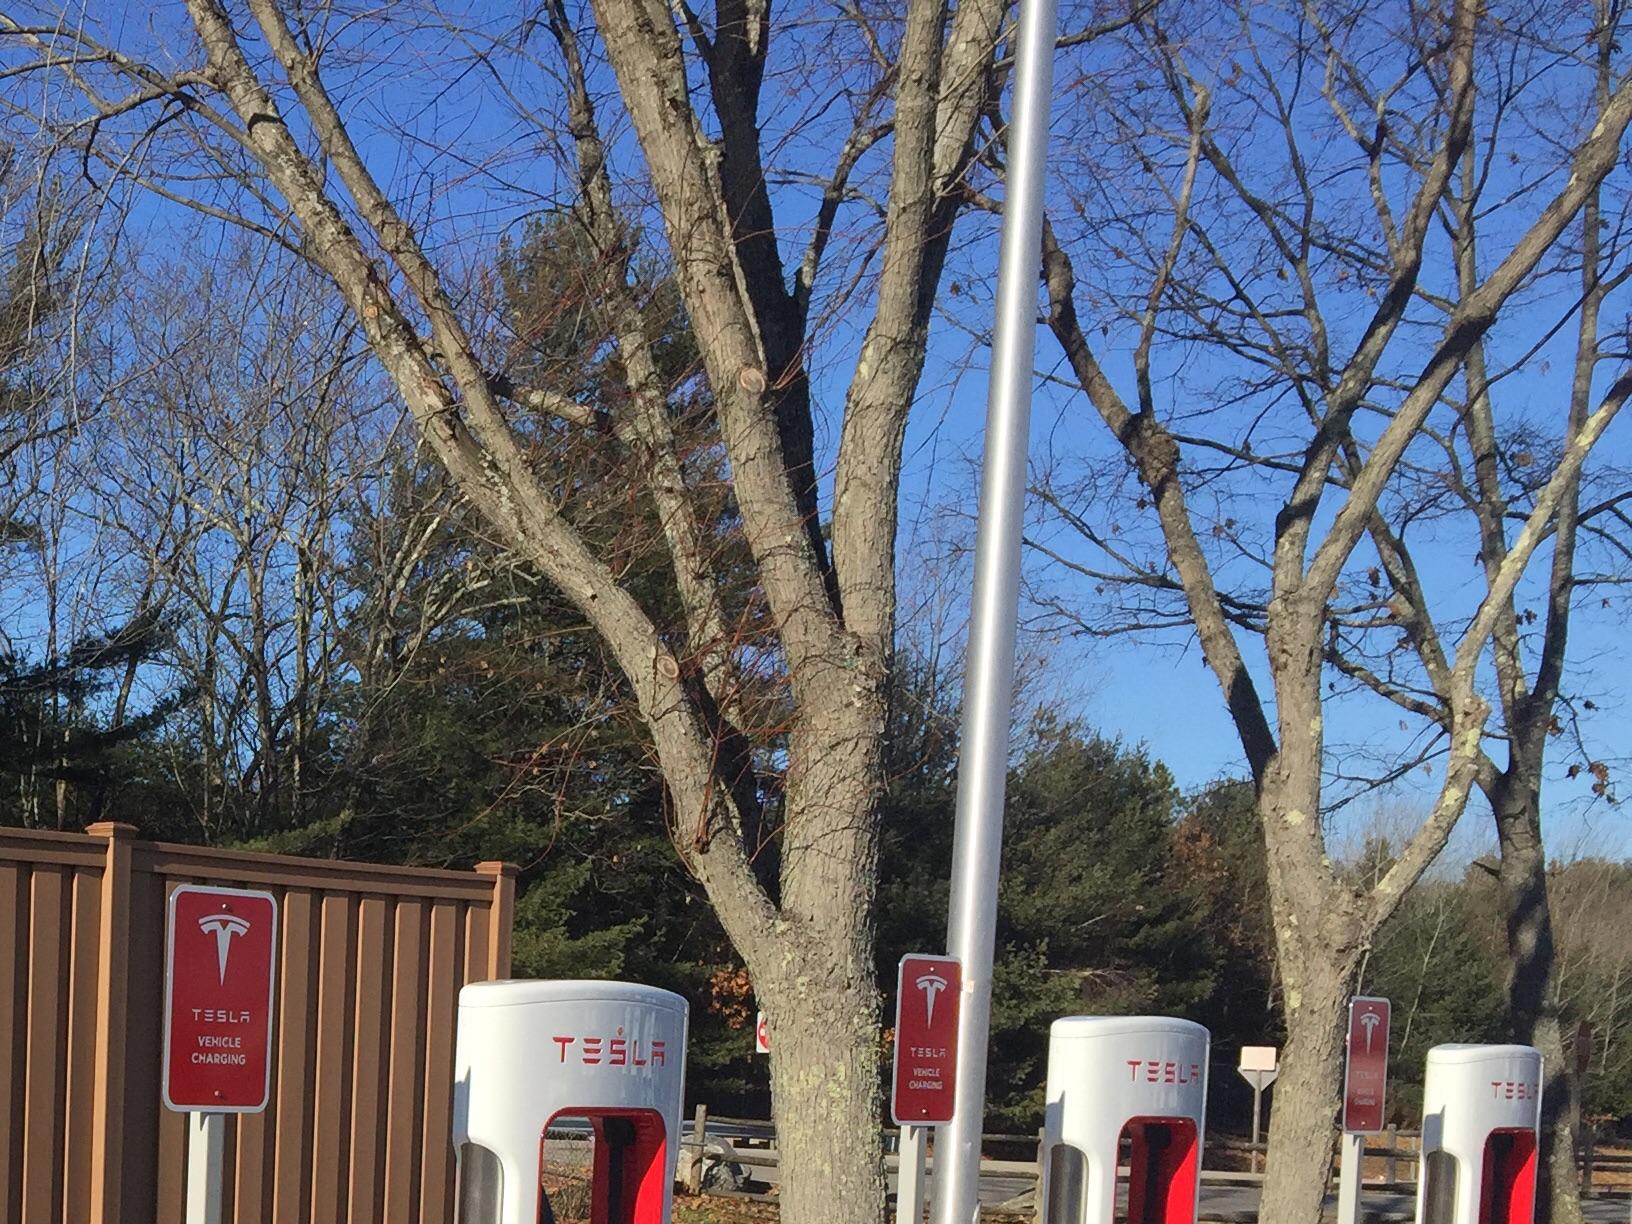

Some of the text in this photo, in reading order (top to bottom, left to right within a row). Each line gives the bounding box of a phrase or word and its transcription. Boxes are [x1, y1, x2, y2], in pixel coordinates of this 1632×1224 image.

[191, 1008, 250, 1023] TESLA
[198, 1036, 241, 1048] VEHICLE
[191, 1052, 246, 1065] CHARGING
[552, 1036, 666, 1067] TESLA
[910, 1047, 946, 1058] TESLA
[1127, 1060, 1199, 1084] TESLA
